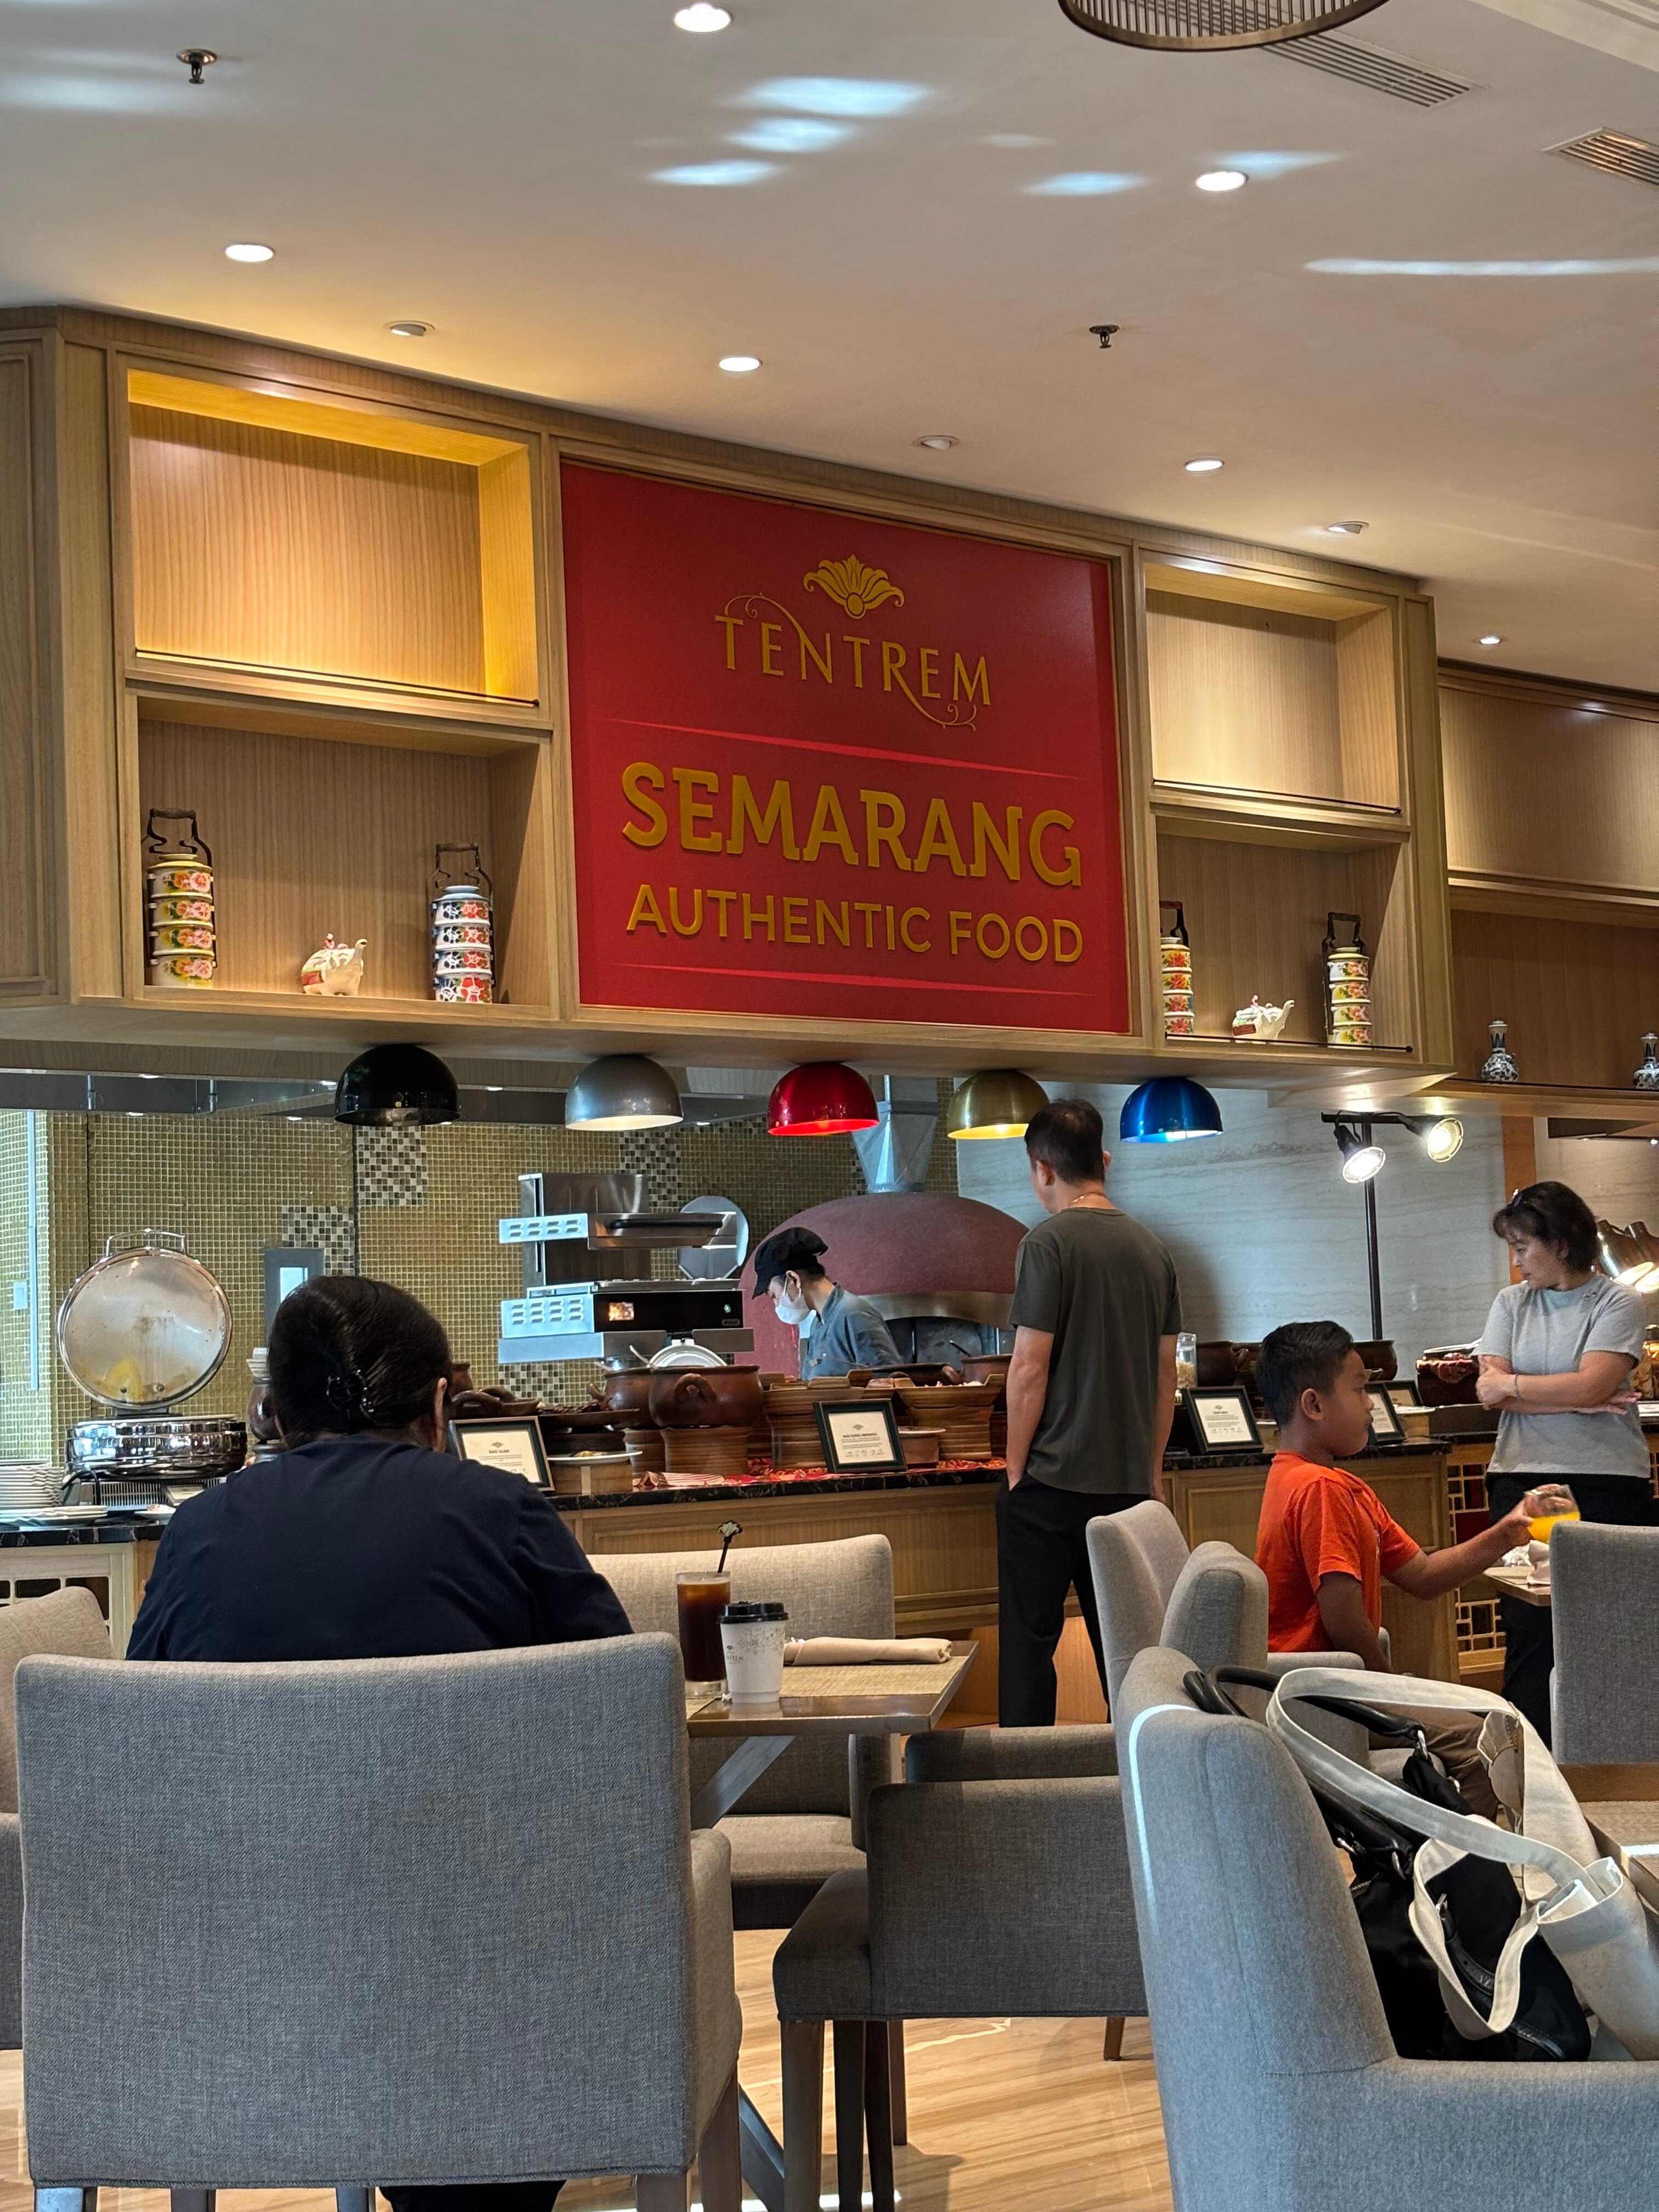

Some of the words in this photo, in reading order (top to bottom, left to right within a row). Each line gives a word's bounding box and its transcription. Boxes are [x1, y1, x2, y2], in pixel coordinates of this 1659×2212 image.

[715, 592, 992, 731] TENTREM
[622, 761, 1082, 888] SEMARANG
[626, 884, 932, 953] AUTHENTIC
[950, 911, 1084, 963] FOOD
